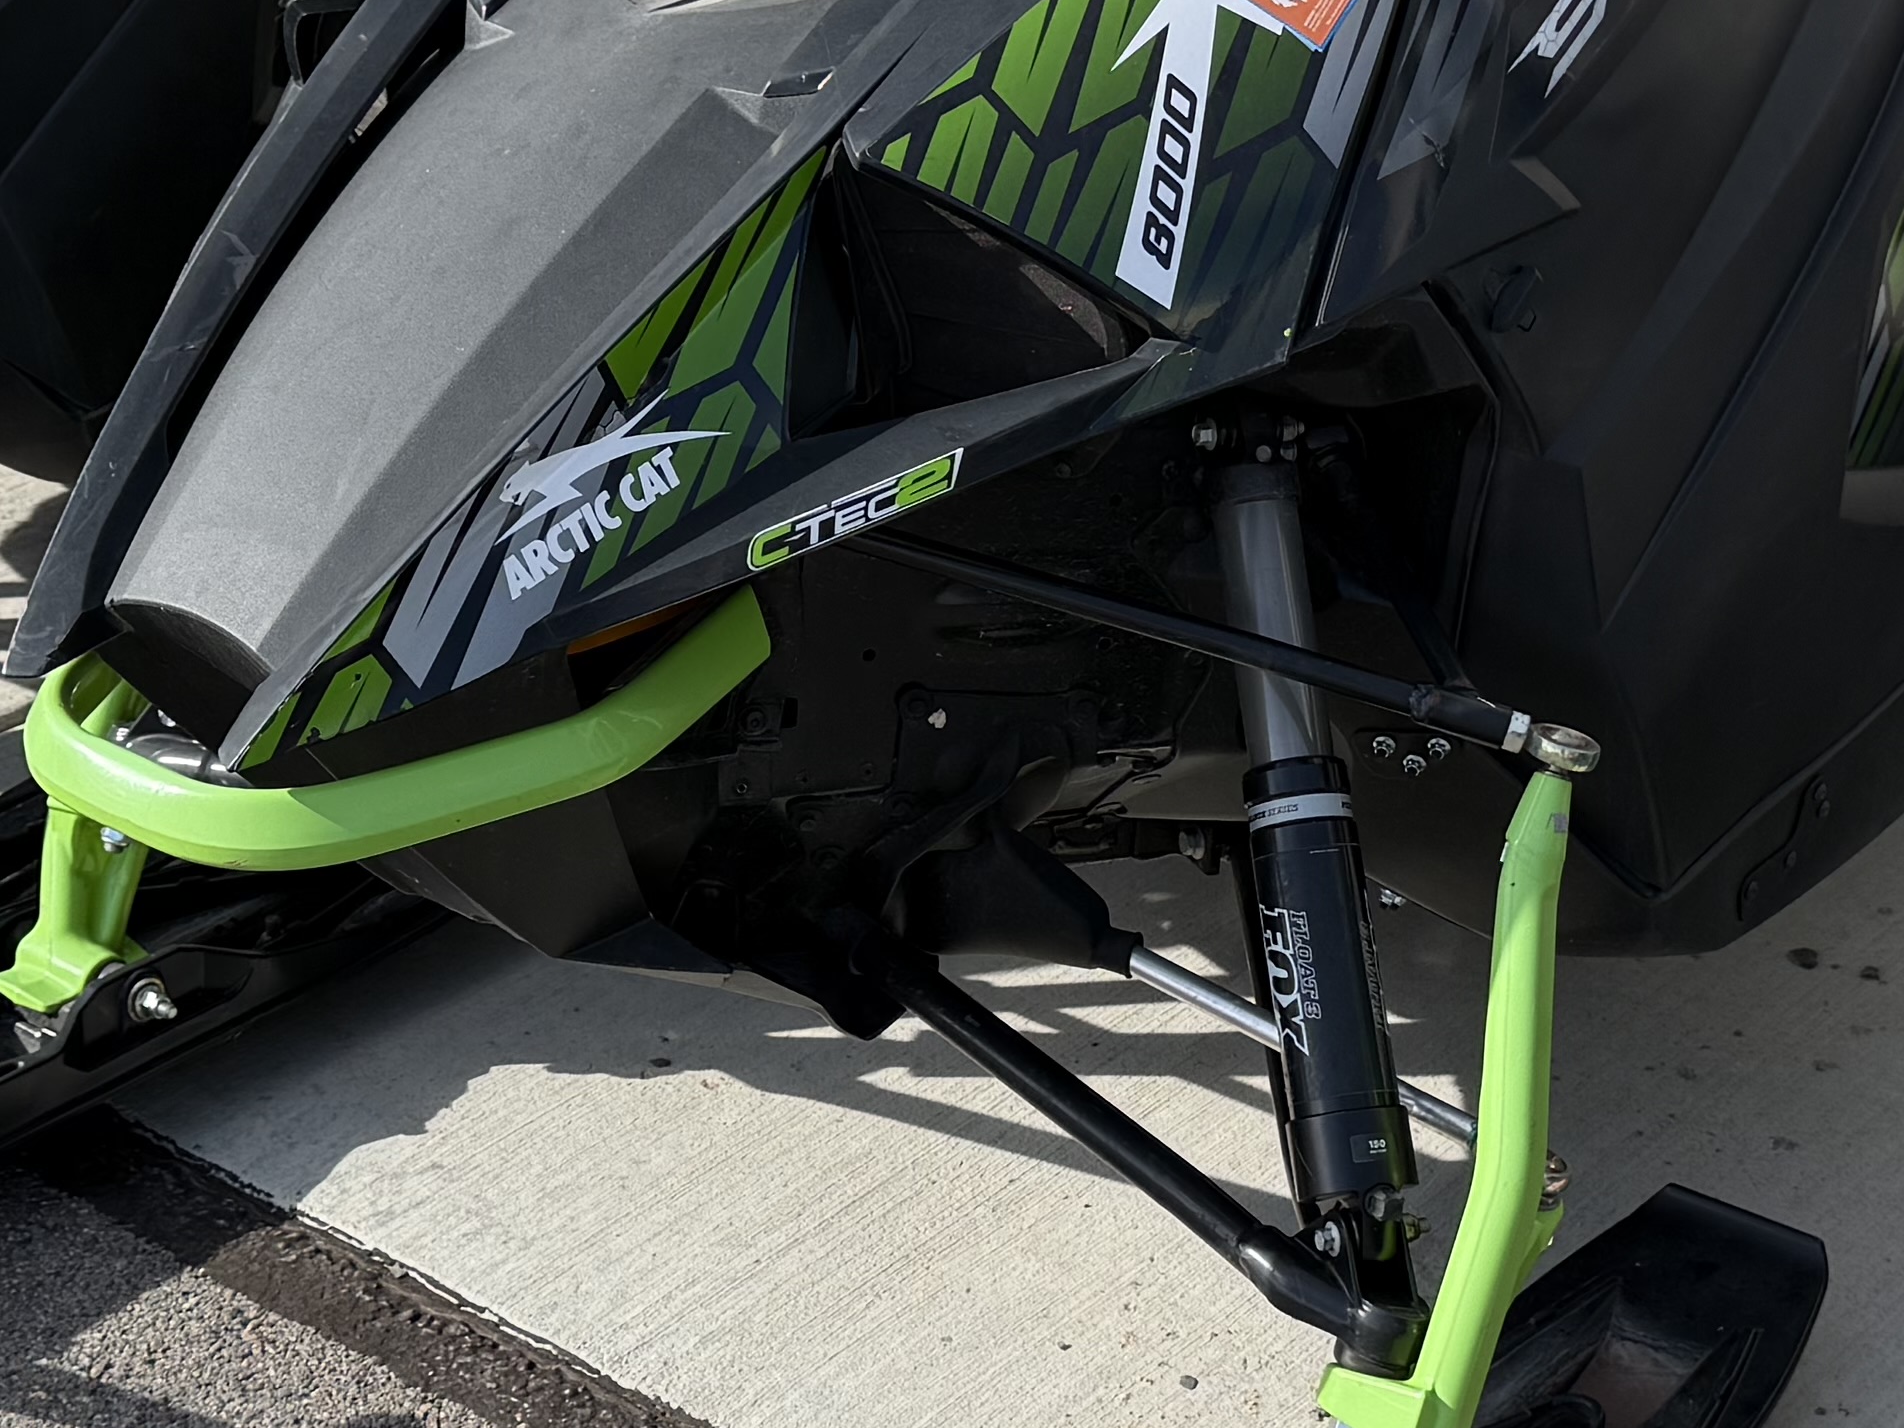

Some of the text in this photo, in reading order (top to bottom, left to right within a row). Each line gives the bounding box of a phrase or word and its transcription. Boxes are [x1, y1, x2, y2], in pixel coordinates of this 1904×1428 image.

[1142, 73, 1197, 271] 8000
[502, 446, 682, 601] ARCTIC CAT
[750, 457, 953, 569] C-TEC2
[1259, 904, 1309, 1057] FOX
[1289, 910, 1322, 1020] FLOAT 3
